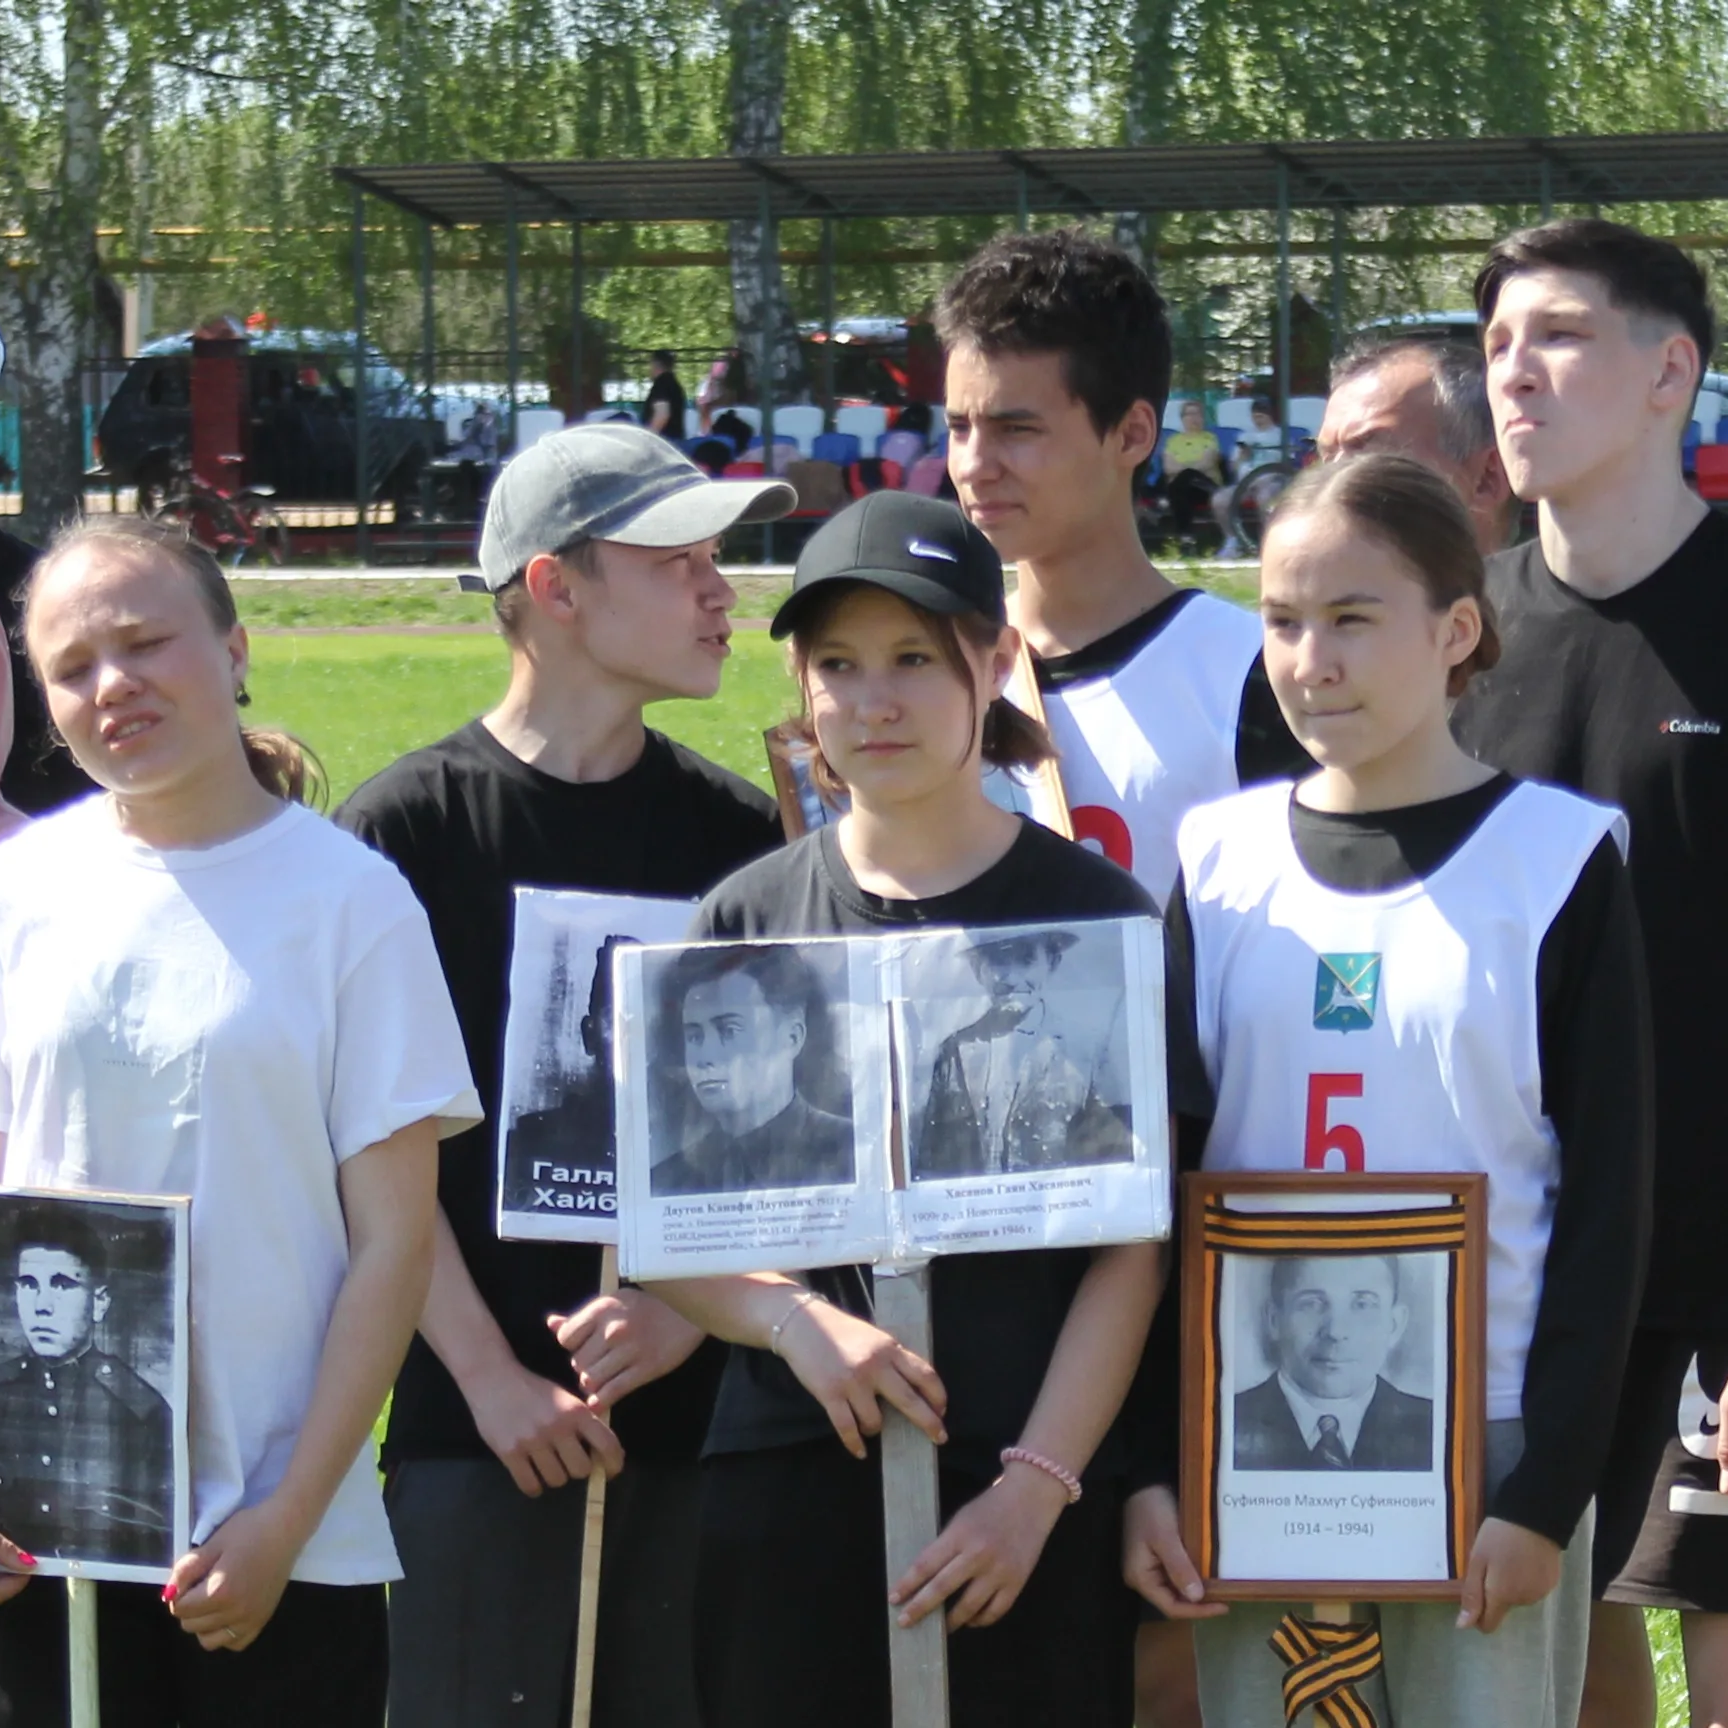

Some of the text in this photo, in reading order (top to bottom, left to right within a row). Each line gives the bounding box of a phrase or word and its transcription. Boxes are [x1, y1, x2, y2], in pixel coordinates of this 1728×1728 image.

[1669, 719, 1720, 734] Columbia
[532, 1187, 618, 1212] Хайб
[1222, 1494, 1436, 1509] Суфиянов Махмут Суфиянович
[1284, 1522, 1321, 1537] (1914
[1337, 1522, 1375, 1537] 1994)
